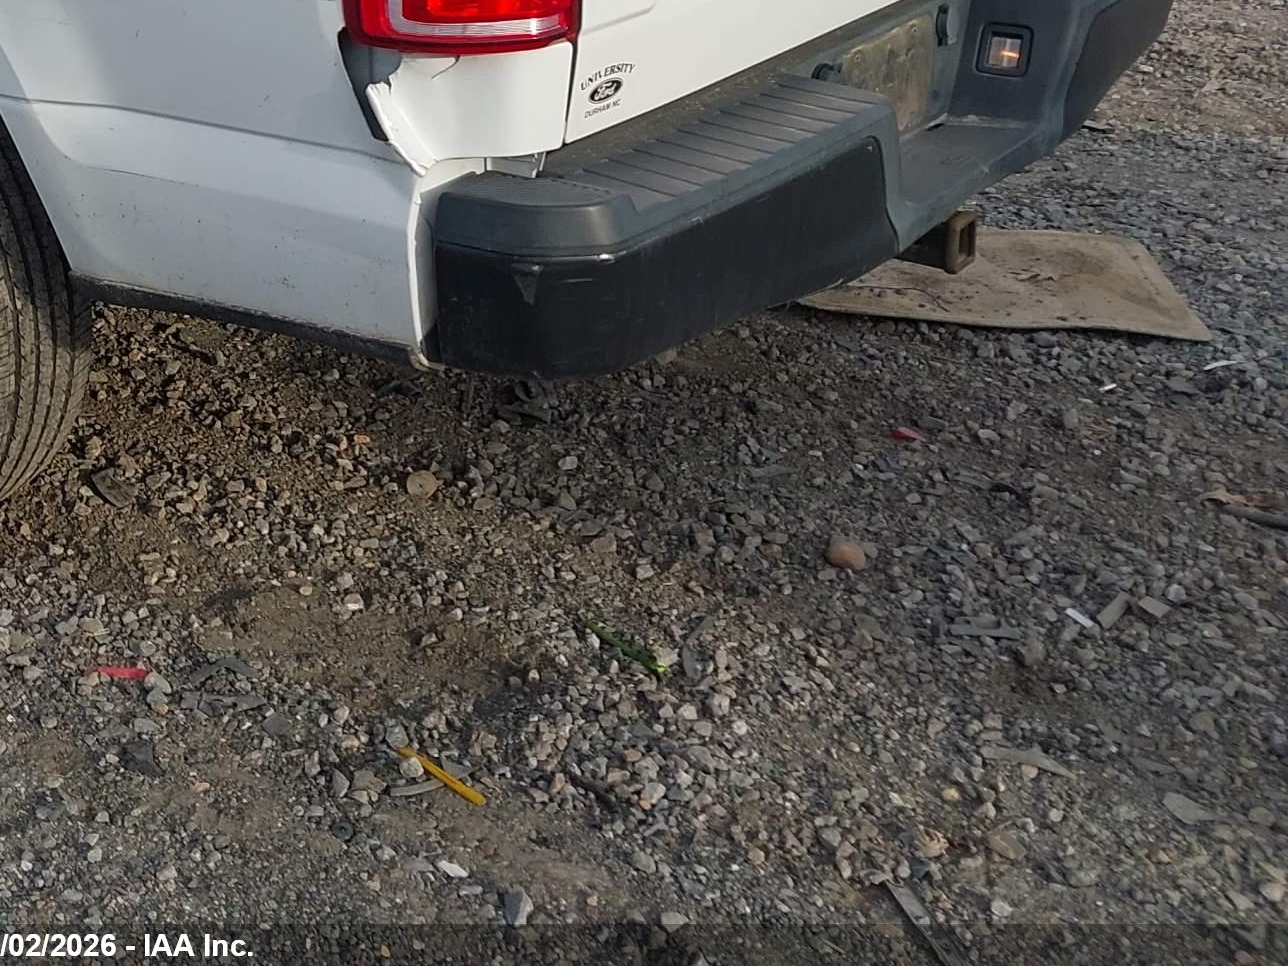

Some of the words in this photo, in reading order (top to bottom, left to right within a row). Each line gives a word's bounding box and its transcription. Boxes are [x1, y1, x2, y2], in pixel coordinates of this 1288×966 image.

[580, 62, 636, 91] UNIVERSITY
[592, 80, 619, 101] Ford
[584, 102, 611, 118] DURHAM
